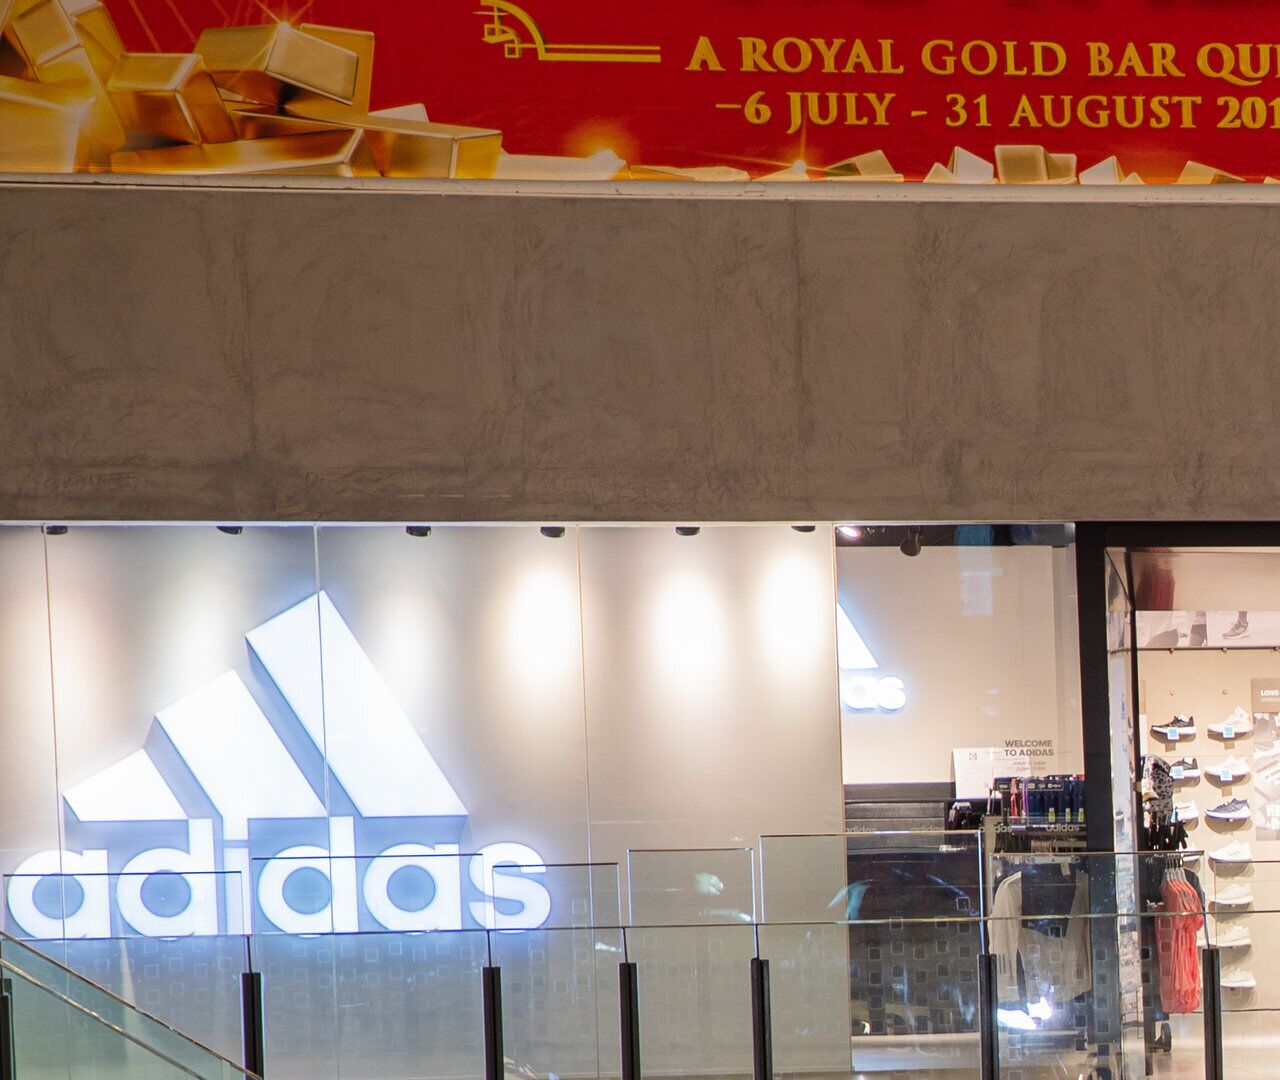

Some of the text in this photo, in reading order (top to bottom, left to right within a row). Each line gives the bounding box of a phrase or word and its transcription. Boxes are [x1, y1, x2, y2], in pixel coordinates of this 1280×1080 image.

[685, 36, 723, 72] A
[739, 36, 904, 76] ROYAL
[921, 40, 1067, 77] GOLD
[1088, 41, 1186, 78] BAR
[785, 91, 897, 134] JULY
[945, 96, 992, 128] 31
[1008, 96, 1202, 129] AUGUST
[1260, 689, 1279, 697] LONG
[1004, 739, 1053, 748] WELCOME
[1004, 749, 1055, 757] TO ADIDAS
[6, 816, 552, 940] adidas
